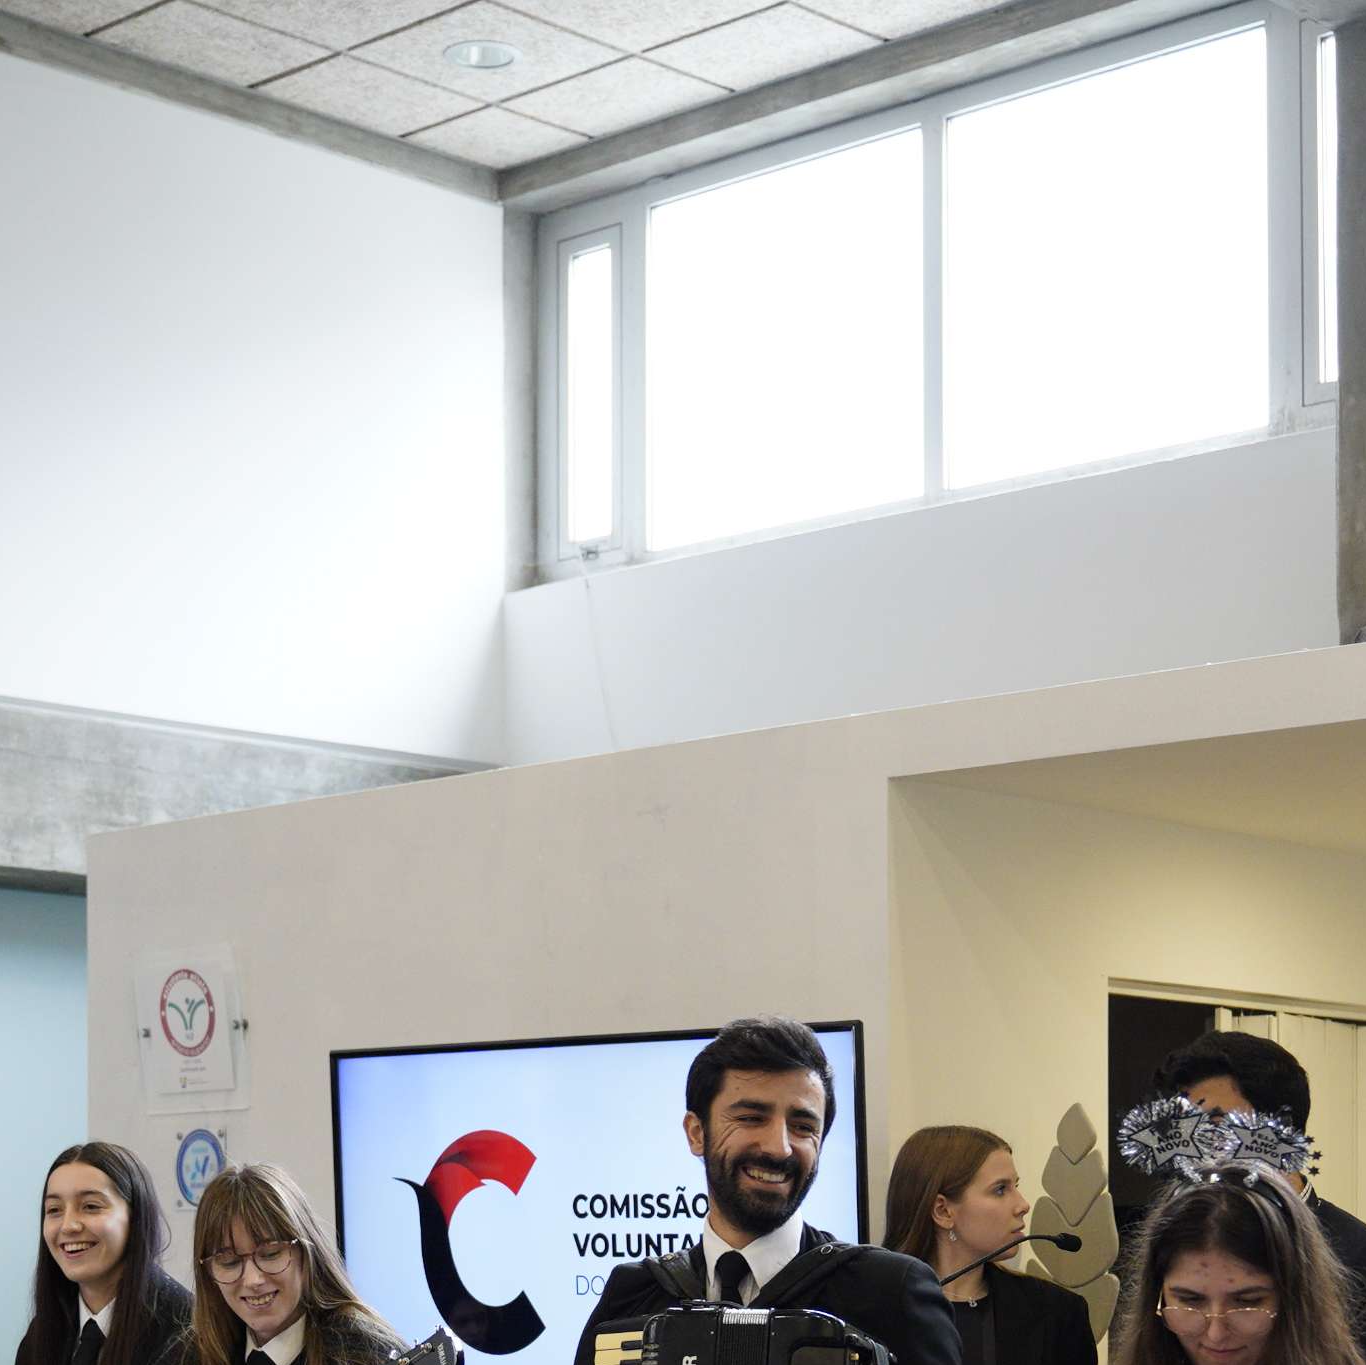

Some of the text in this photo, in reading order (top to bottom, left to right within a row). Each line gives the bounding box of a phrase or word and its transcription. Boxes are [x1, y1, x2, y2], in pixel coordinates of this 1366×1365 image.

[1155, 1129, 1183, 1146] ANO
[1251, 1138, 1278, 1151] ANO
[1155, 1138, 1190, 1155] NOVO
[1244, 1144, 1280, 1159] NOVO
[572, 1186, 710, 1219] COMISSÃO
[573, 1232, 703, 1258] VOLUNTA
[575, 1274, 606, 1295] DO
